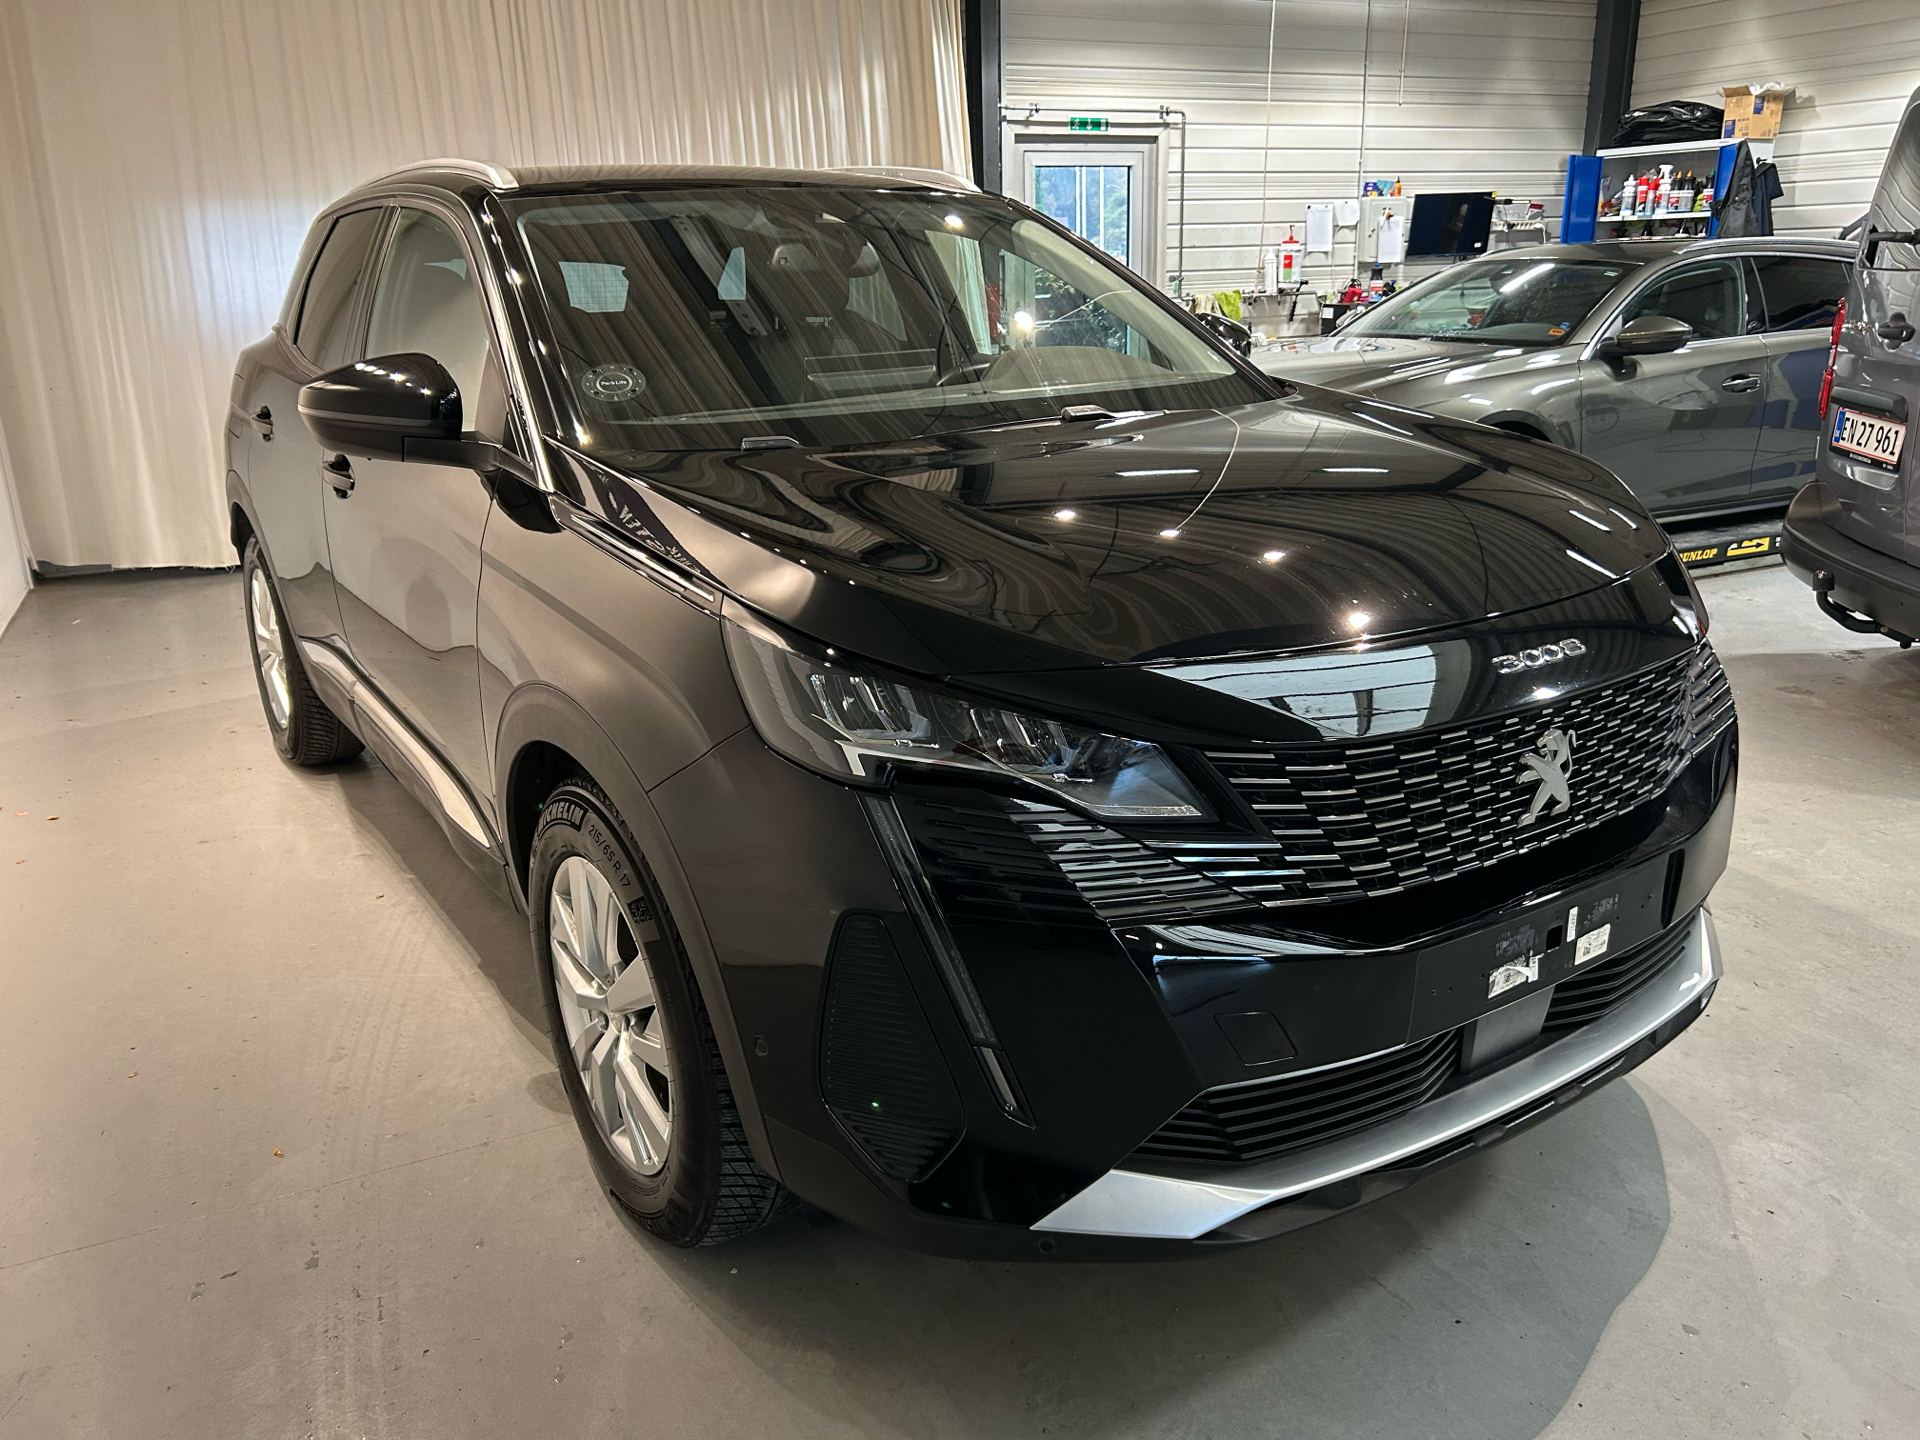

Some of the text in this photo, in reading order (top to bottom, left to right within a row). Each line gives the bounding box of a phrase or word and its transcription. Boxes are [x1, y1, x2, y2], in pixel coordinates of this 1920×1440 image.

[1840, 417, 1900, 456] EN 27 961
[1492, 638, 1587, 674] 3008
[587, 824, 631, 887] 215/65 R 17
